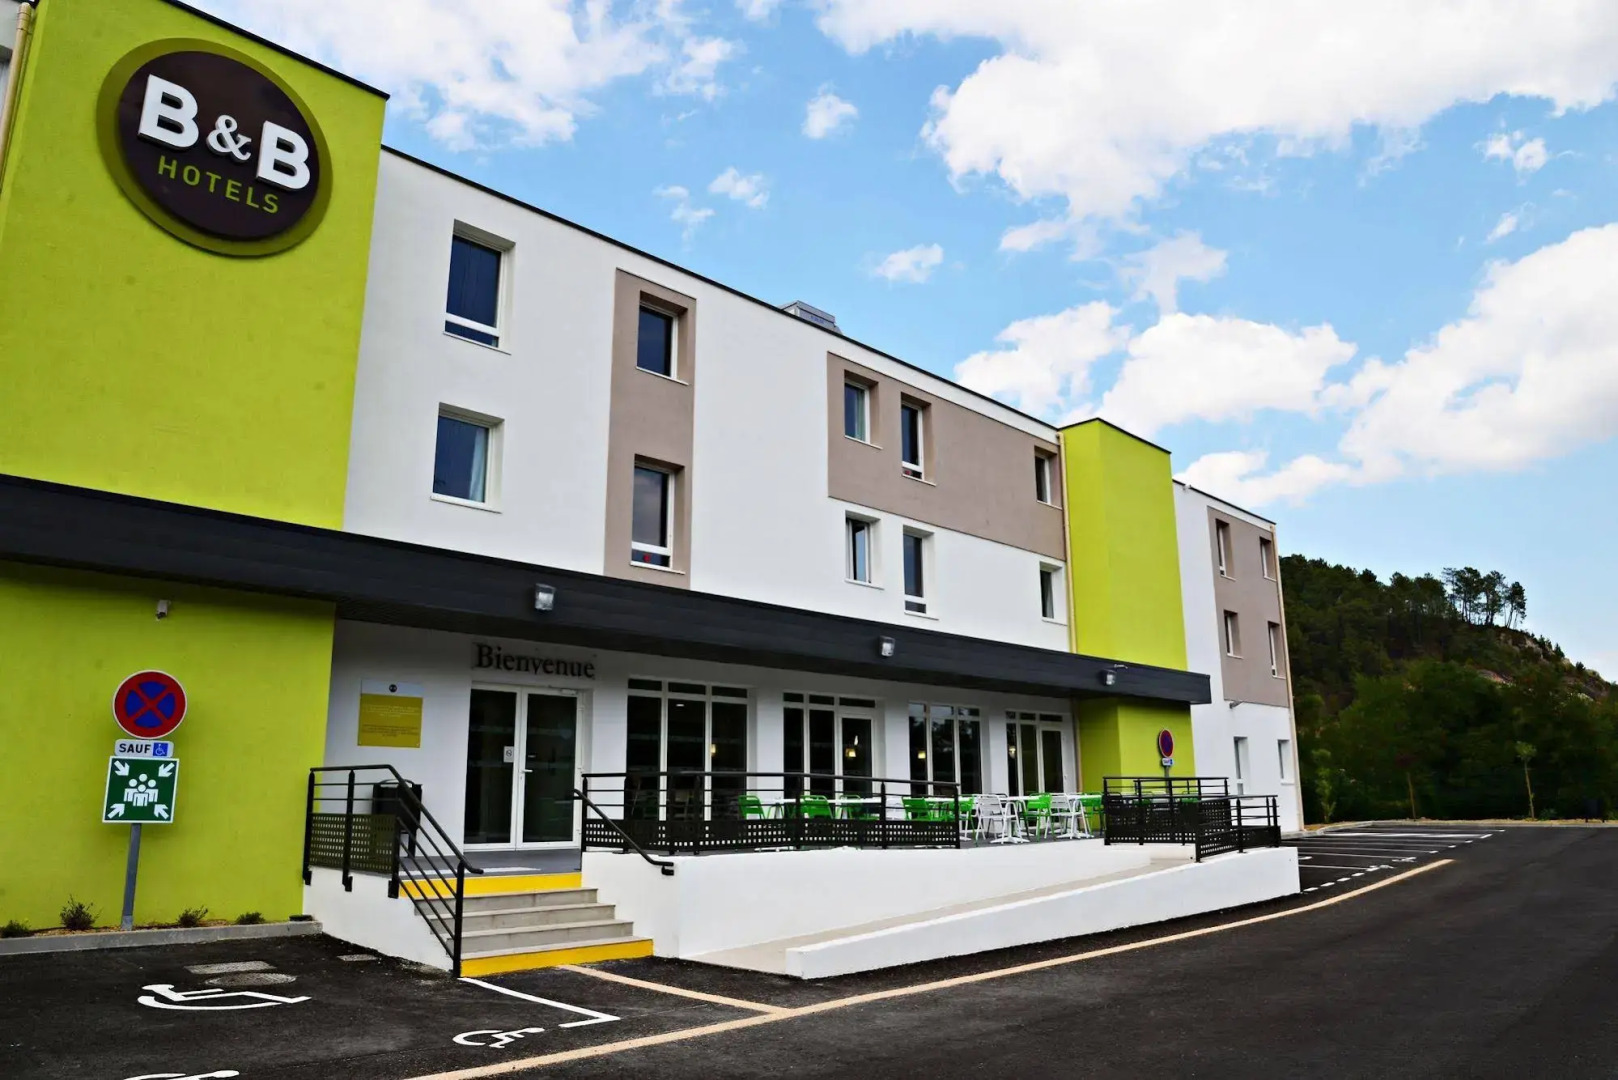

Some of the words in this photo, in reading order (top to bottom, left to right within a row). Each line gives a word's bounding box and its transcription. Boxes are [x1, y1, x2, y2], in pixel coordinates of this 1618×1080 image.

[157, 155, 280, 214] HOTELS
[475, 642, 596, 679] Bienvenue
[118, 743, 151, 754] SAUF
